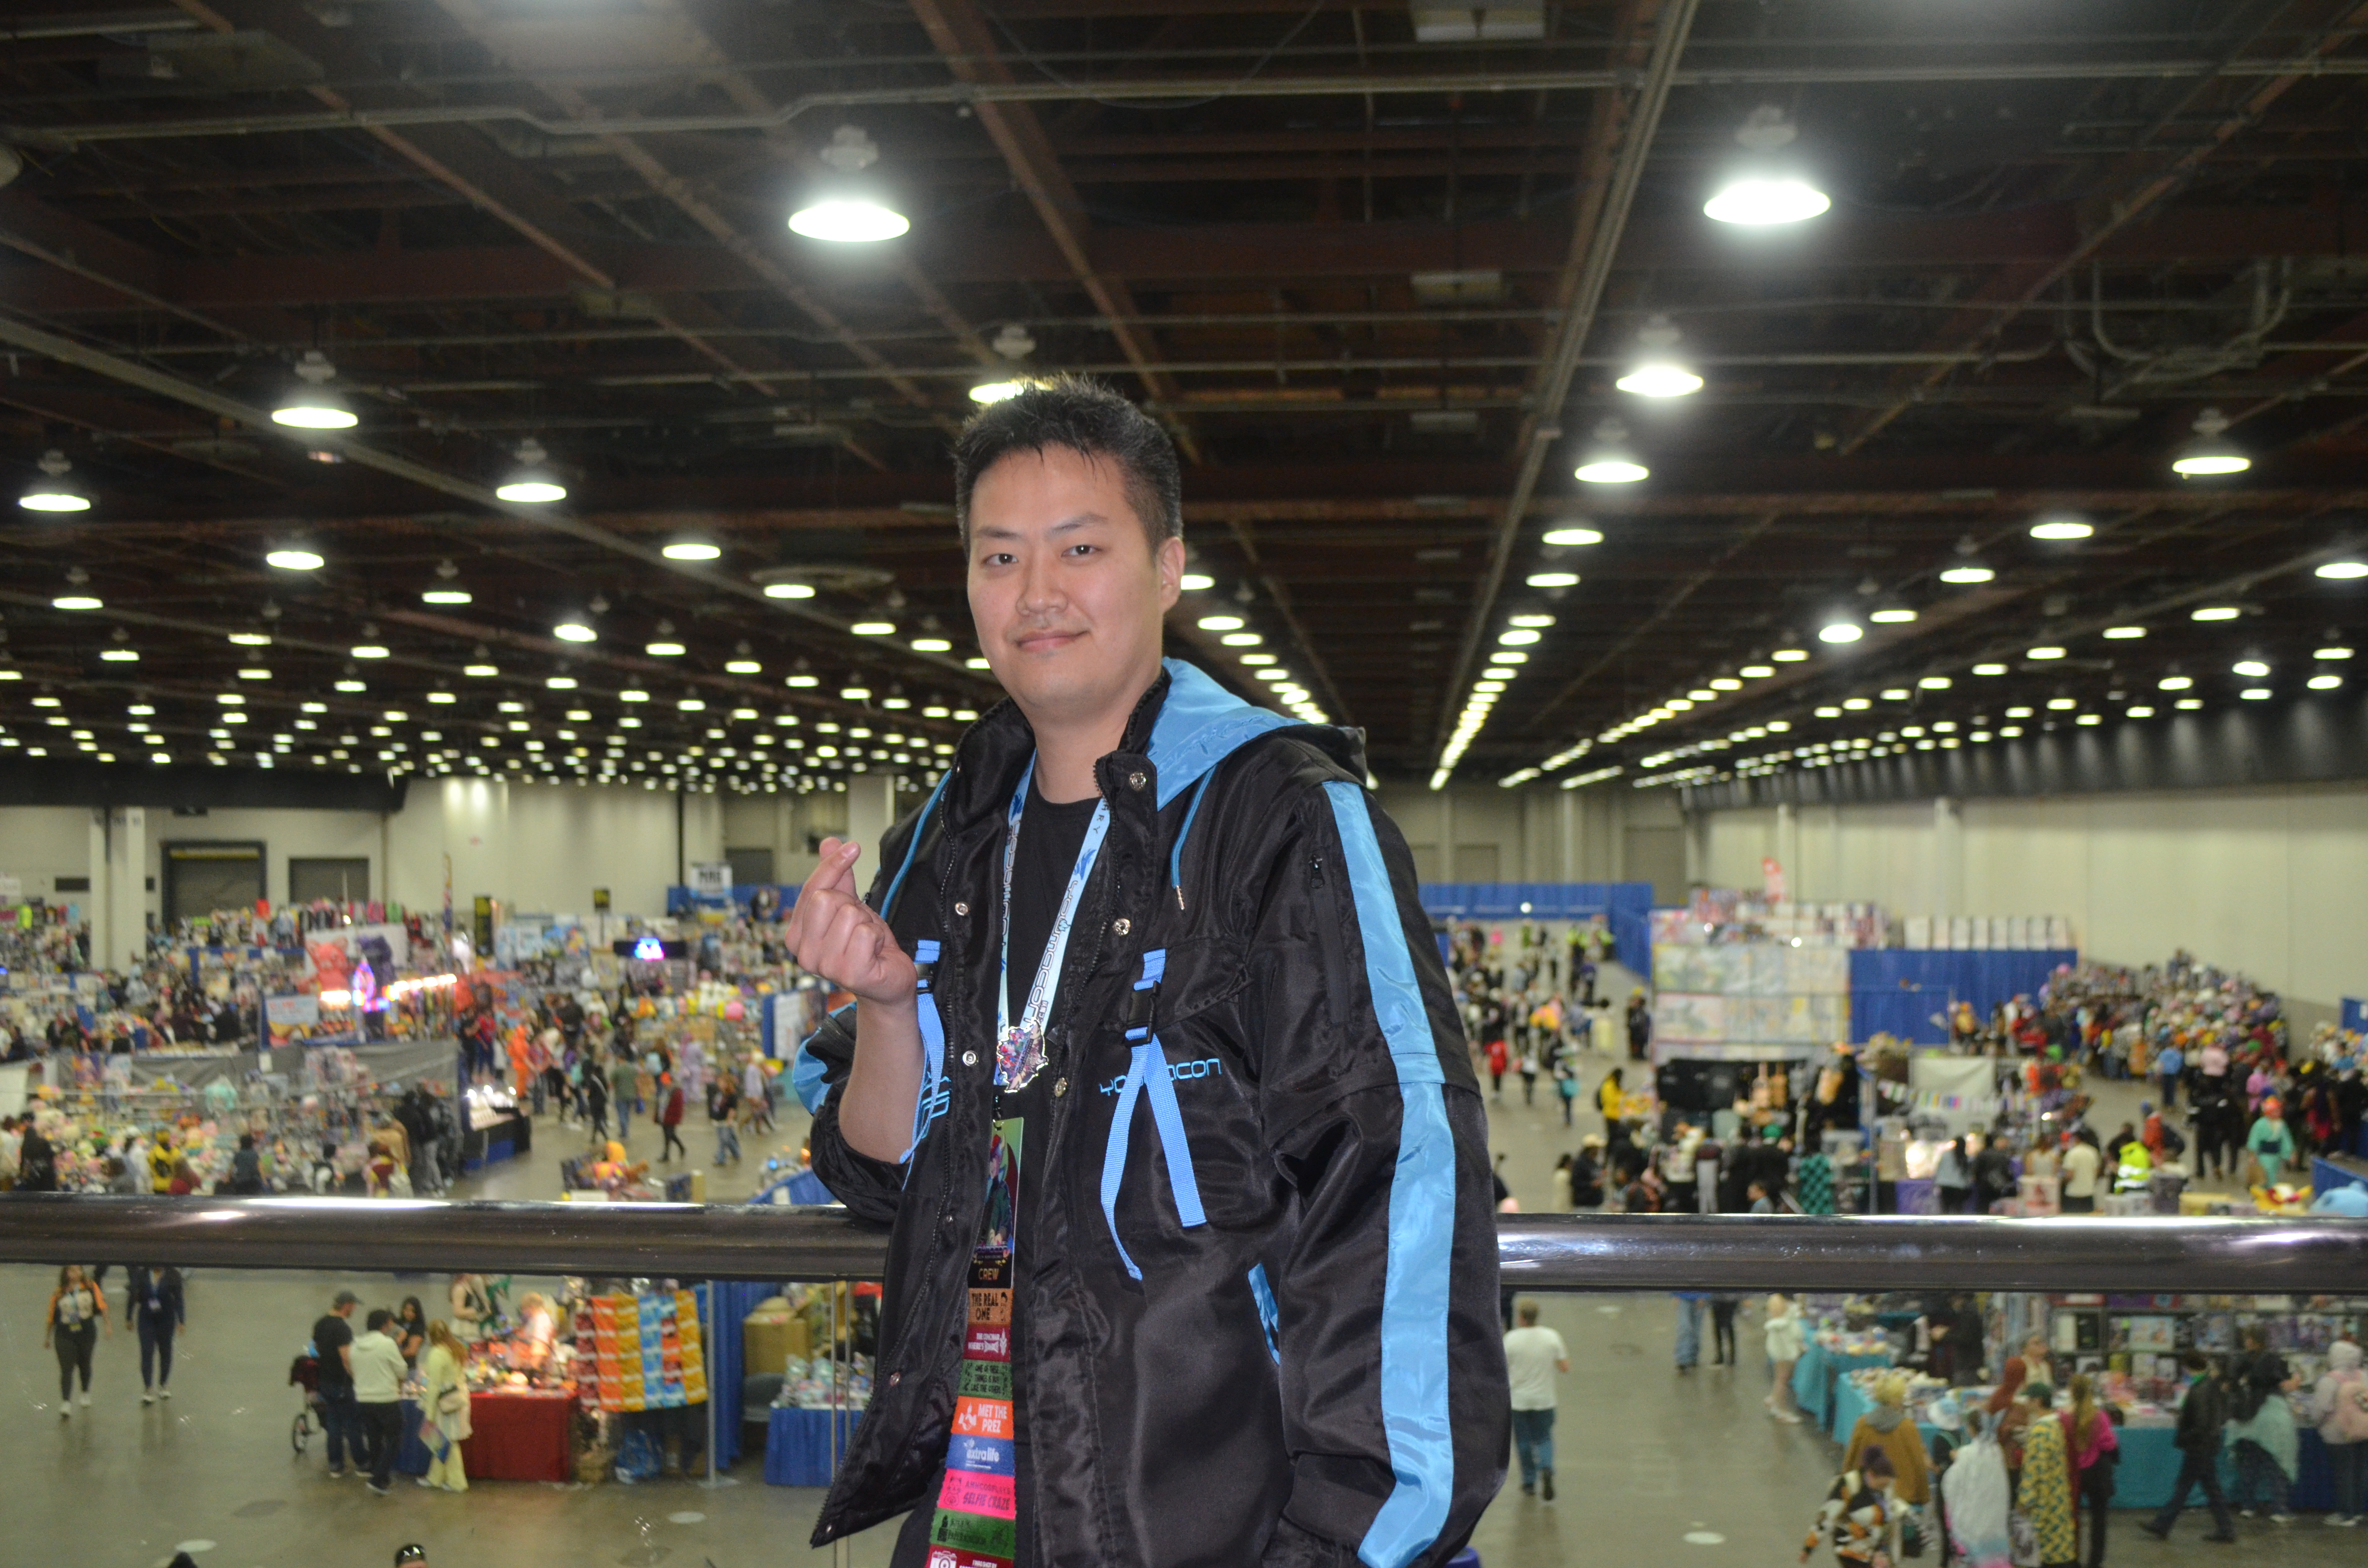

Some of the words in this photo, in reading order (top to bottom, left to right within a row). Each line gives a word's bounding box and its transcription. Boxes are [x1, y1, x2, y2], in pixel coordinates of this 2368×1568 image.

[978, 1268, 999, 1281] CREW
[972, 1293, 982, 1307] THE
[983, 1293, 999, 1307] REAL
[975, 1307, 990, 1321] ONE
[978, 1403, 994, 1417] MET
[995, 1405, 1007, 1420] THE
[982, 1418, 1001, 1433] PREZ
[962, 1492, 987, 1507] SELFIE
[987, 1495, 1011, 1510] CRAZE
